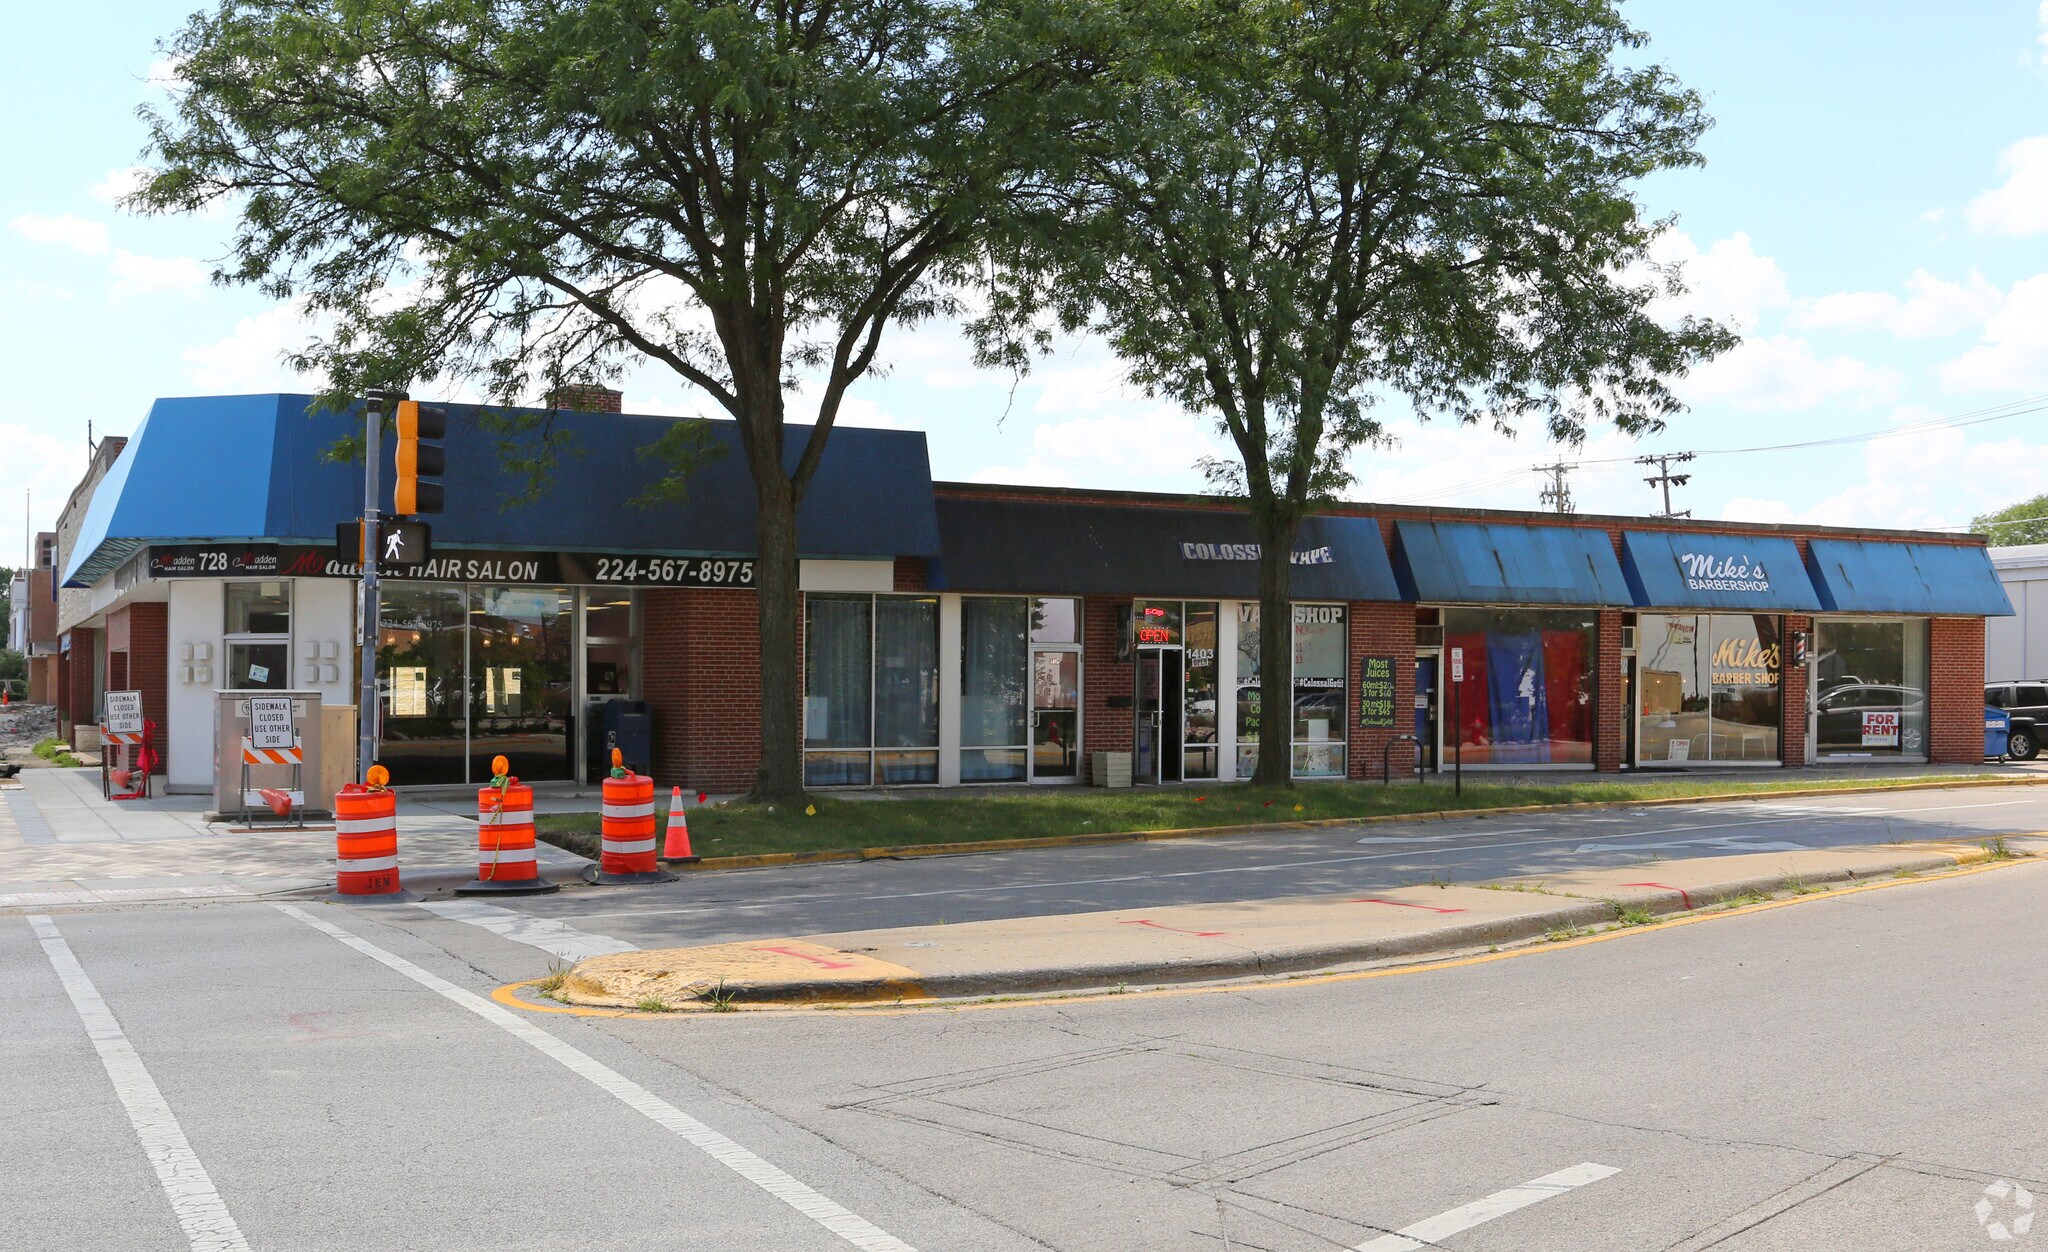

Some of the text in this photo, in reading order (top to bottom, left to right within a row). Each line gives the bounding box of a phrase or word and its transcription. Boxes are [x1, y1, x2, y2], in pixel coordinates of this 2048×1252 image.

[1181, 542, 1333, 565] COLOSS VAPE
[199, 552, 228, 571] 728
[1682, 553, 1765, 579] Mike's
[465, 559, 539, 581] SALON
[595, 558, 754, 584] 224-567-8975
[1688, 579, 1769, 591] BARBERSHOP
[1238, 604, 1343, 624] VA SHOP
[1140, 629, 1169, 642] OPEN
[1186, 648, 1214, 660] 1403
[1712, 637, 1780, 669] Mike's
[1369, 659, 1388, 668] Most
[1366, 668, 1390, 677] Juices
[1712, 672, 1780, 685] BARBER SHOP
[109, 695, 137, 703] SIDEWALK
[113, 704, 135, 712] CLOSED
[254, 702, 288, 711] SIDEWALK
[1367, 707, 1378, 715] for
[109, 712, 140, 721] USE OTHER
[259, 713, 284, 722] CLOSED
[1867, 713, 1895, 725] FOR
[119, 721, 132, 729] SIDE
[254, 724, 290, 733] USE OTHER
[1861, 724, 1899, 736] RENT
[265, 735, 281, 744] SIDE
